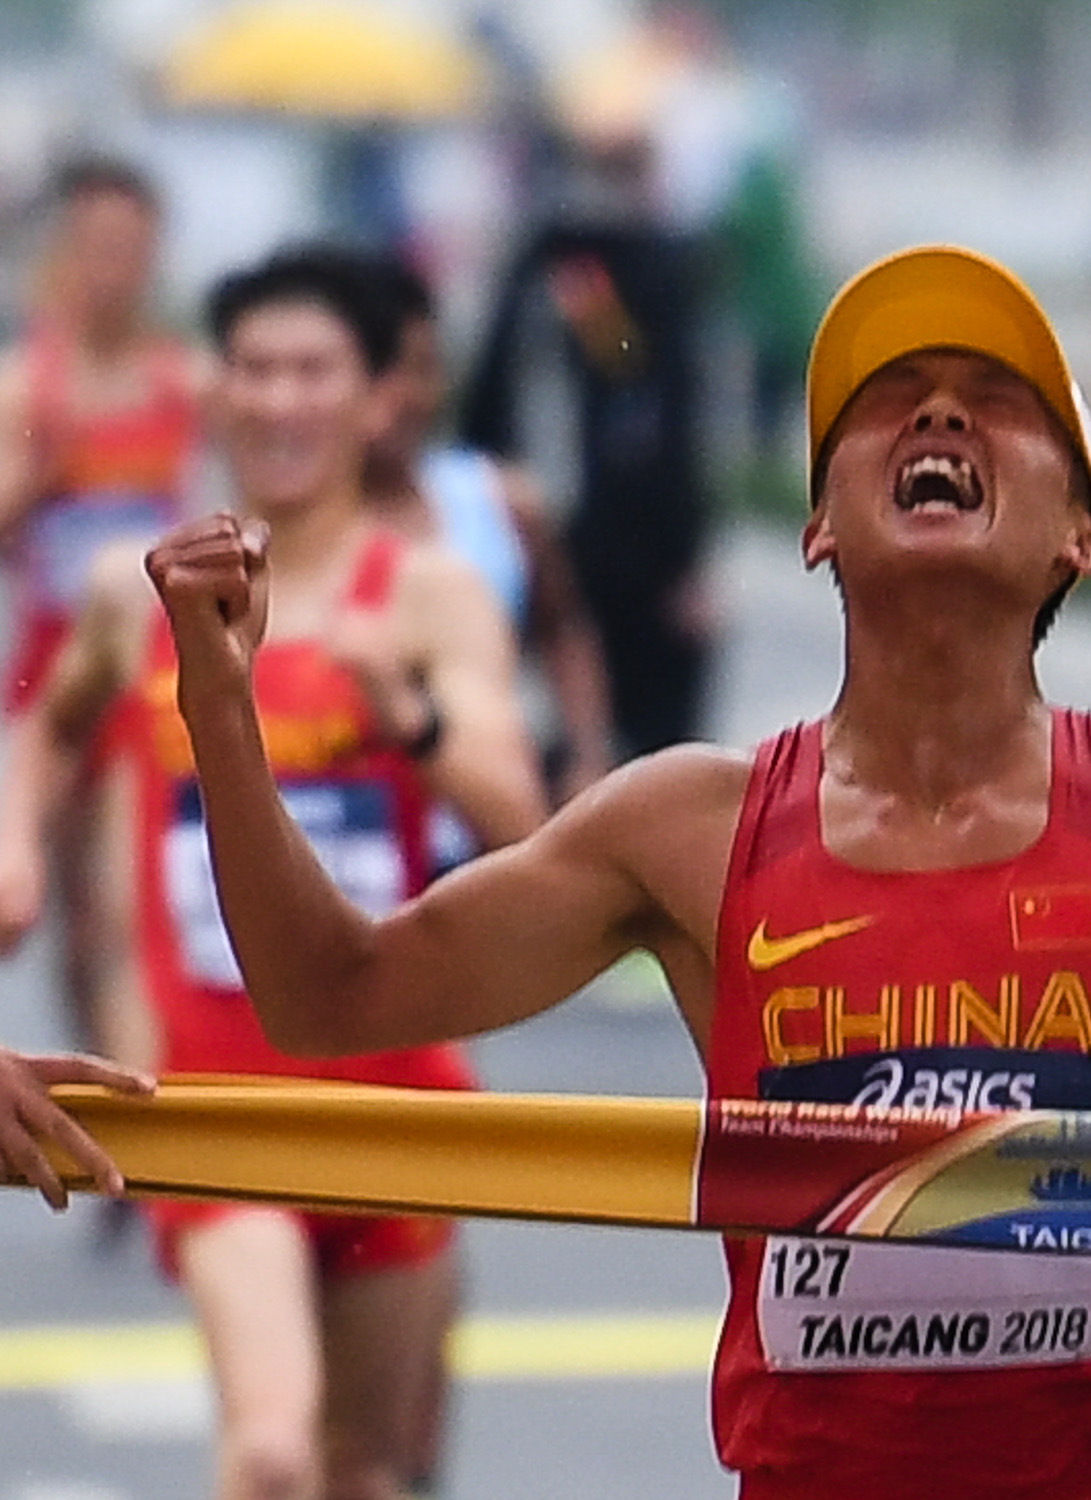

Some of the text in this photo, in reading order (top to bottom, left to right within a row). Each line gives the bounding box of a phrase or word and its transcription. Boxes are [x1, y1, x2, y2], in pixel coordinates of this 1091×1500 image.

[772, 1244, 850, 1298] 127
[801, 1304, 1090, 1359] TAICANG 2018
